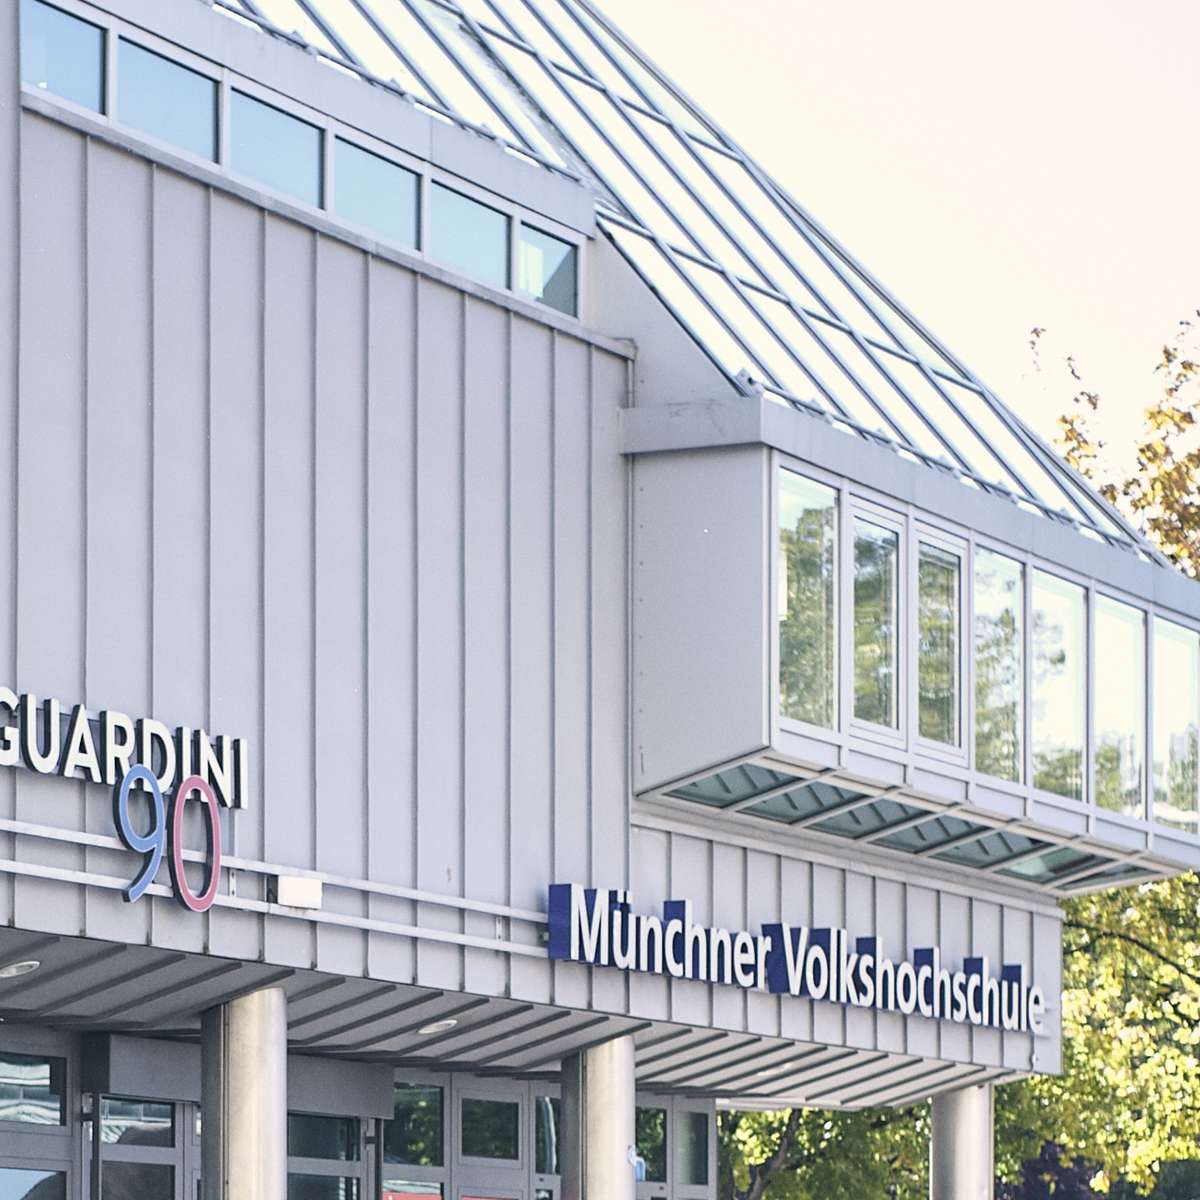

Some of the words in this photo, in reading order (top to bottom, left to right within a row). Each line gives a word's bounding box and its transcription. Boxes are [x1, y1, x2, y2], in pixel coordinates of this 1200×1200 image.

[114, 764, 222, 913] 90
[554, 883, 773, 990] Münchner
[771, 922, 1045, 1034] Volkshochschule
